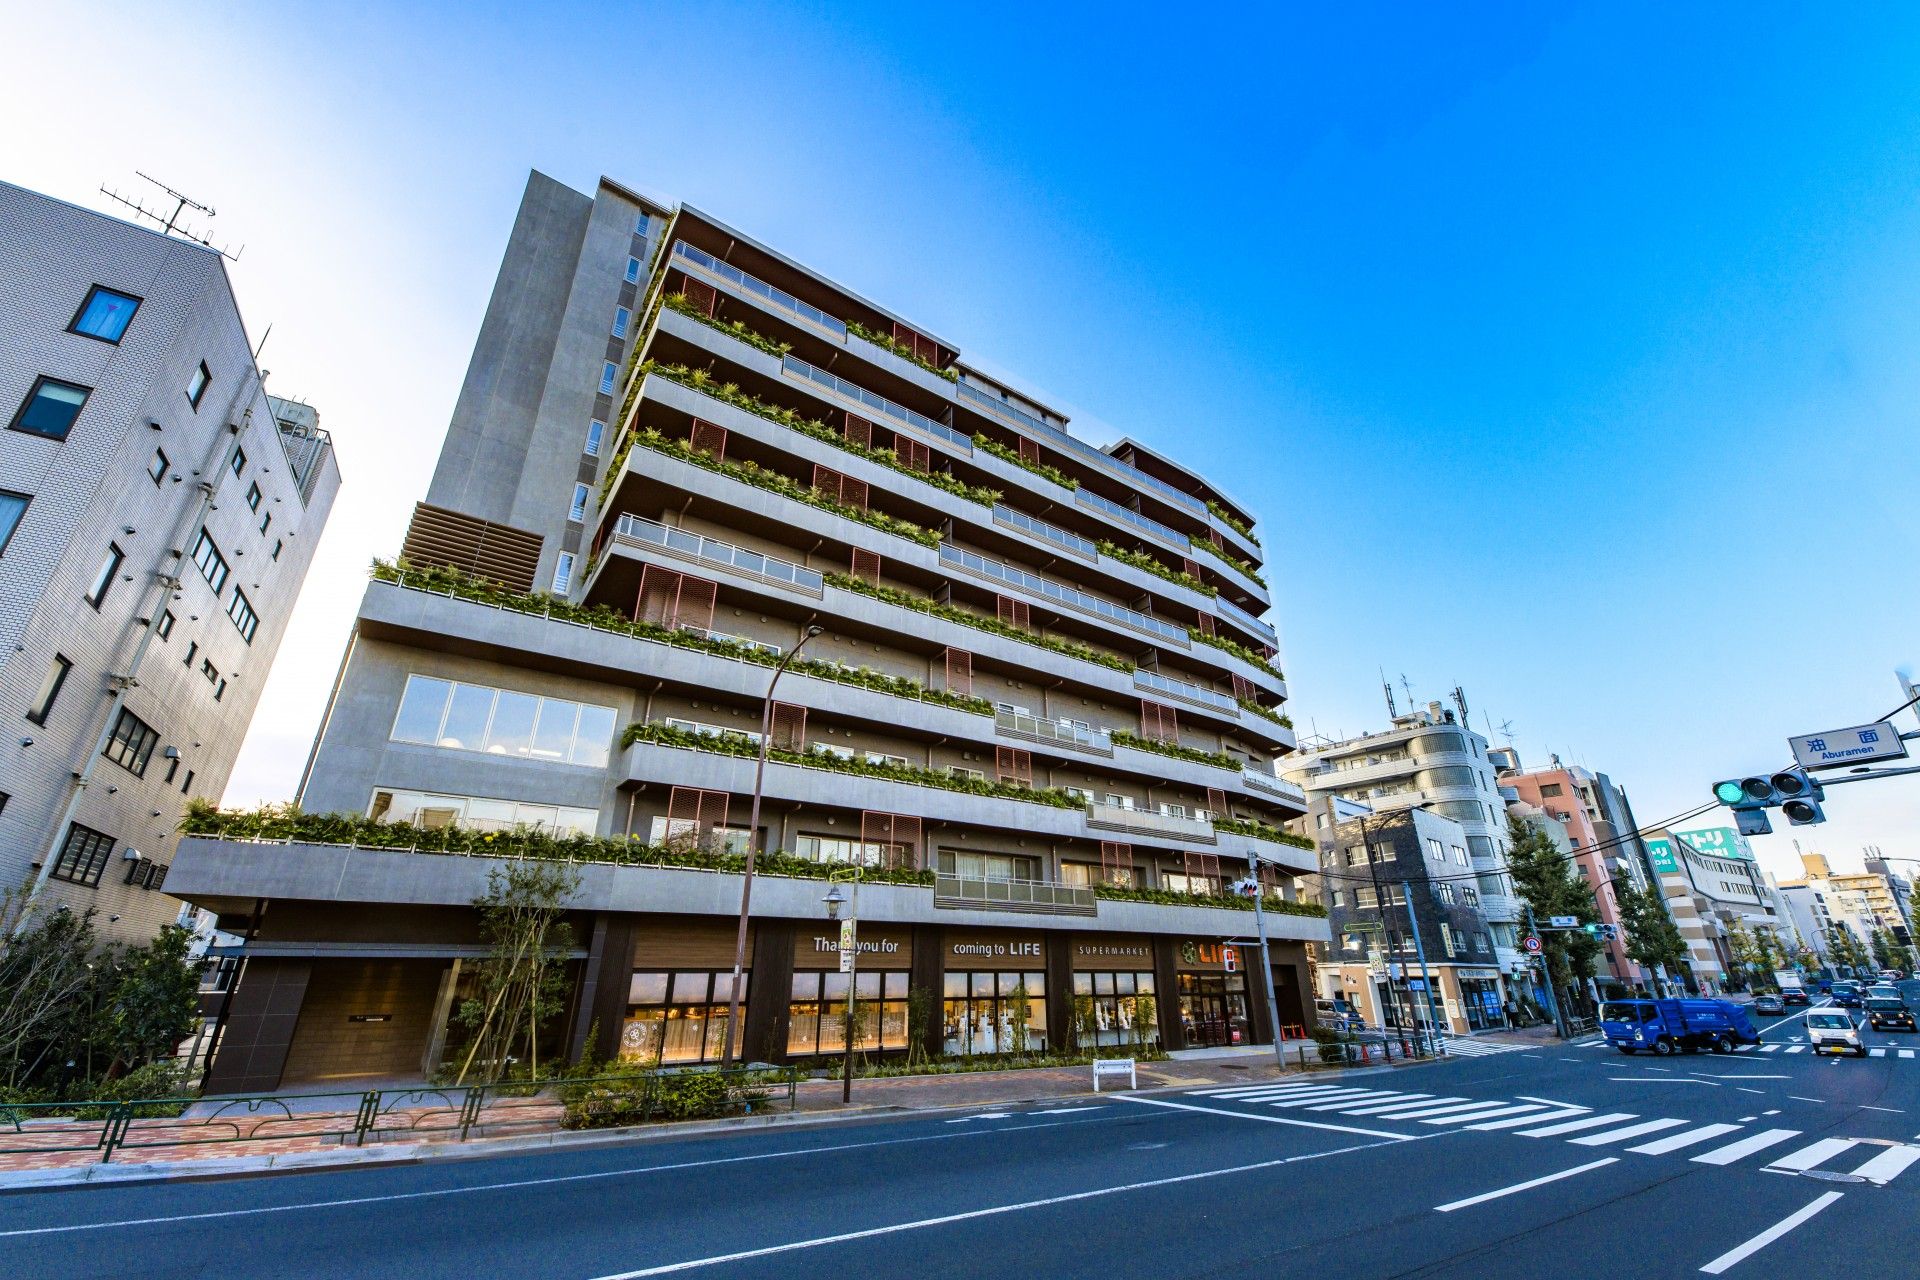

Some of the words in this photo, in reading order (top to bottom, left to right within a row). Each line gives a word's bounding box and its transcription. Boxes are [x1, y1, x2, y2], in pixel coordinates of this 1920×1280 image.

[1806, 729, 1879, 752] 油面
[1822, 746, 1875, 760] Aburamen
[1681, 831, 1724, 849] トリ
[856, 941, 879, 955] you
[881, 939, 899, 952] for
[953, 941, 992, 957] coming
[994, 944, 1005, 955] to
[1010, 942, 1041, 955] LIFE
[1079, 946, 1149, 956] SUPERMARKET
